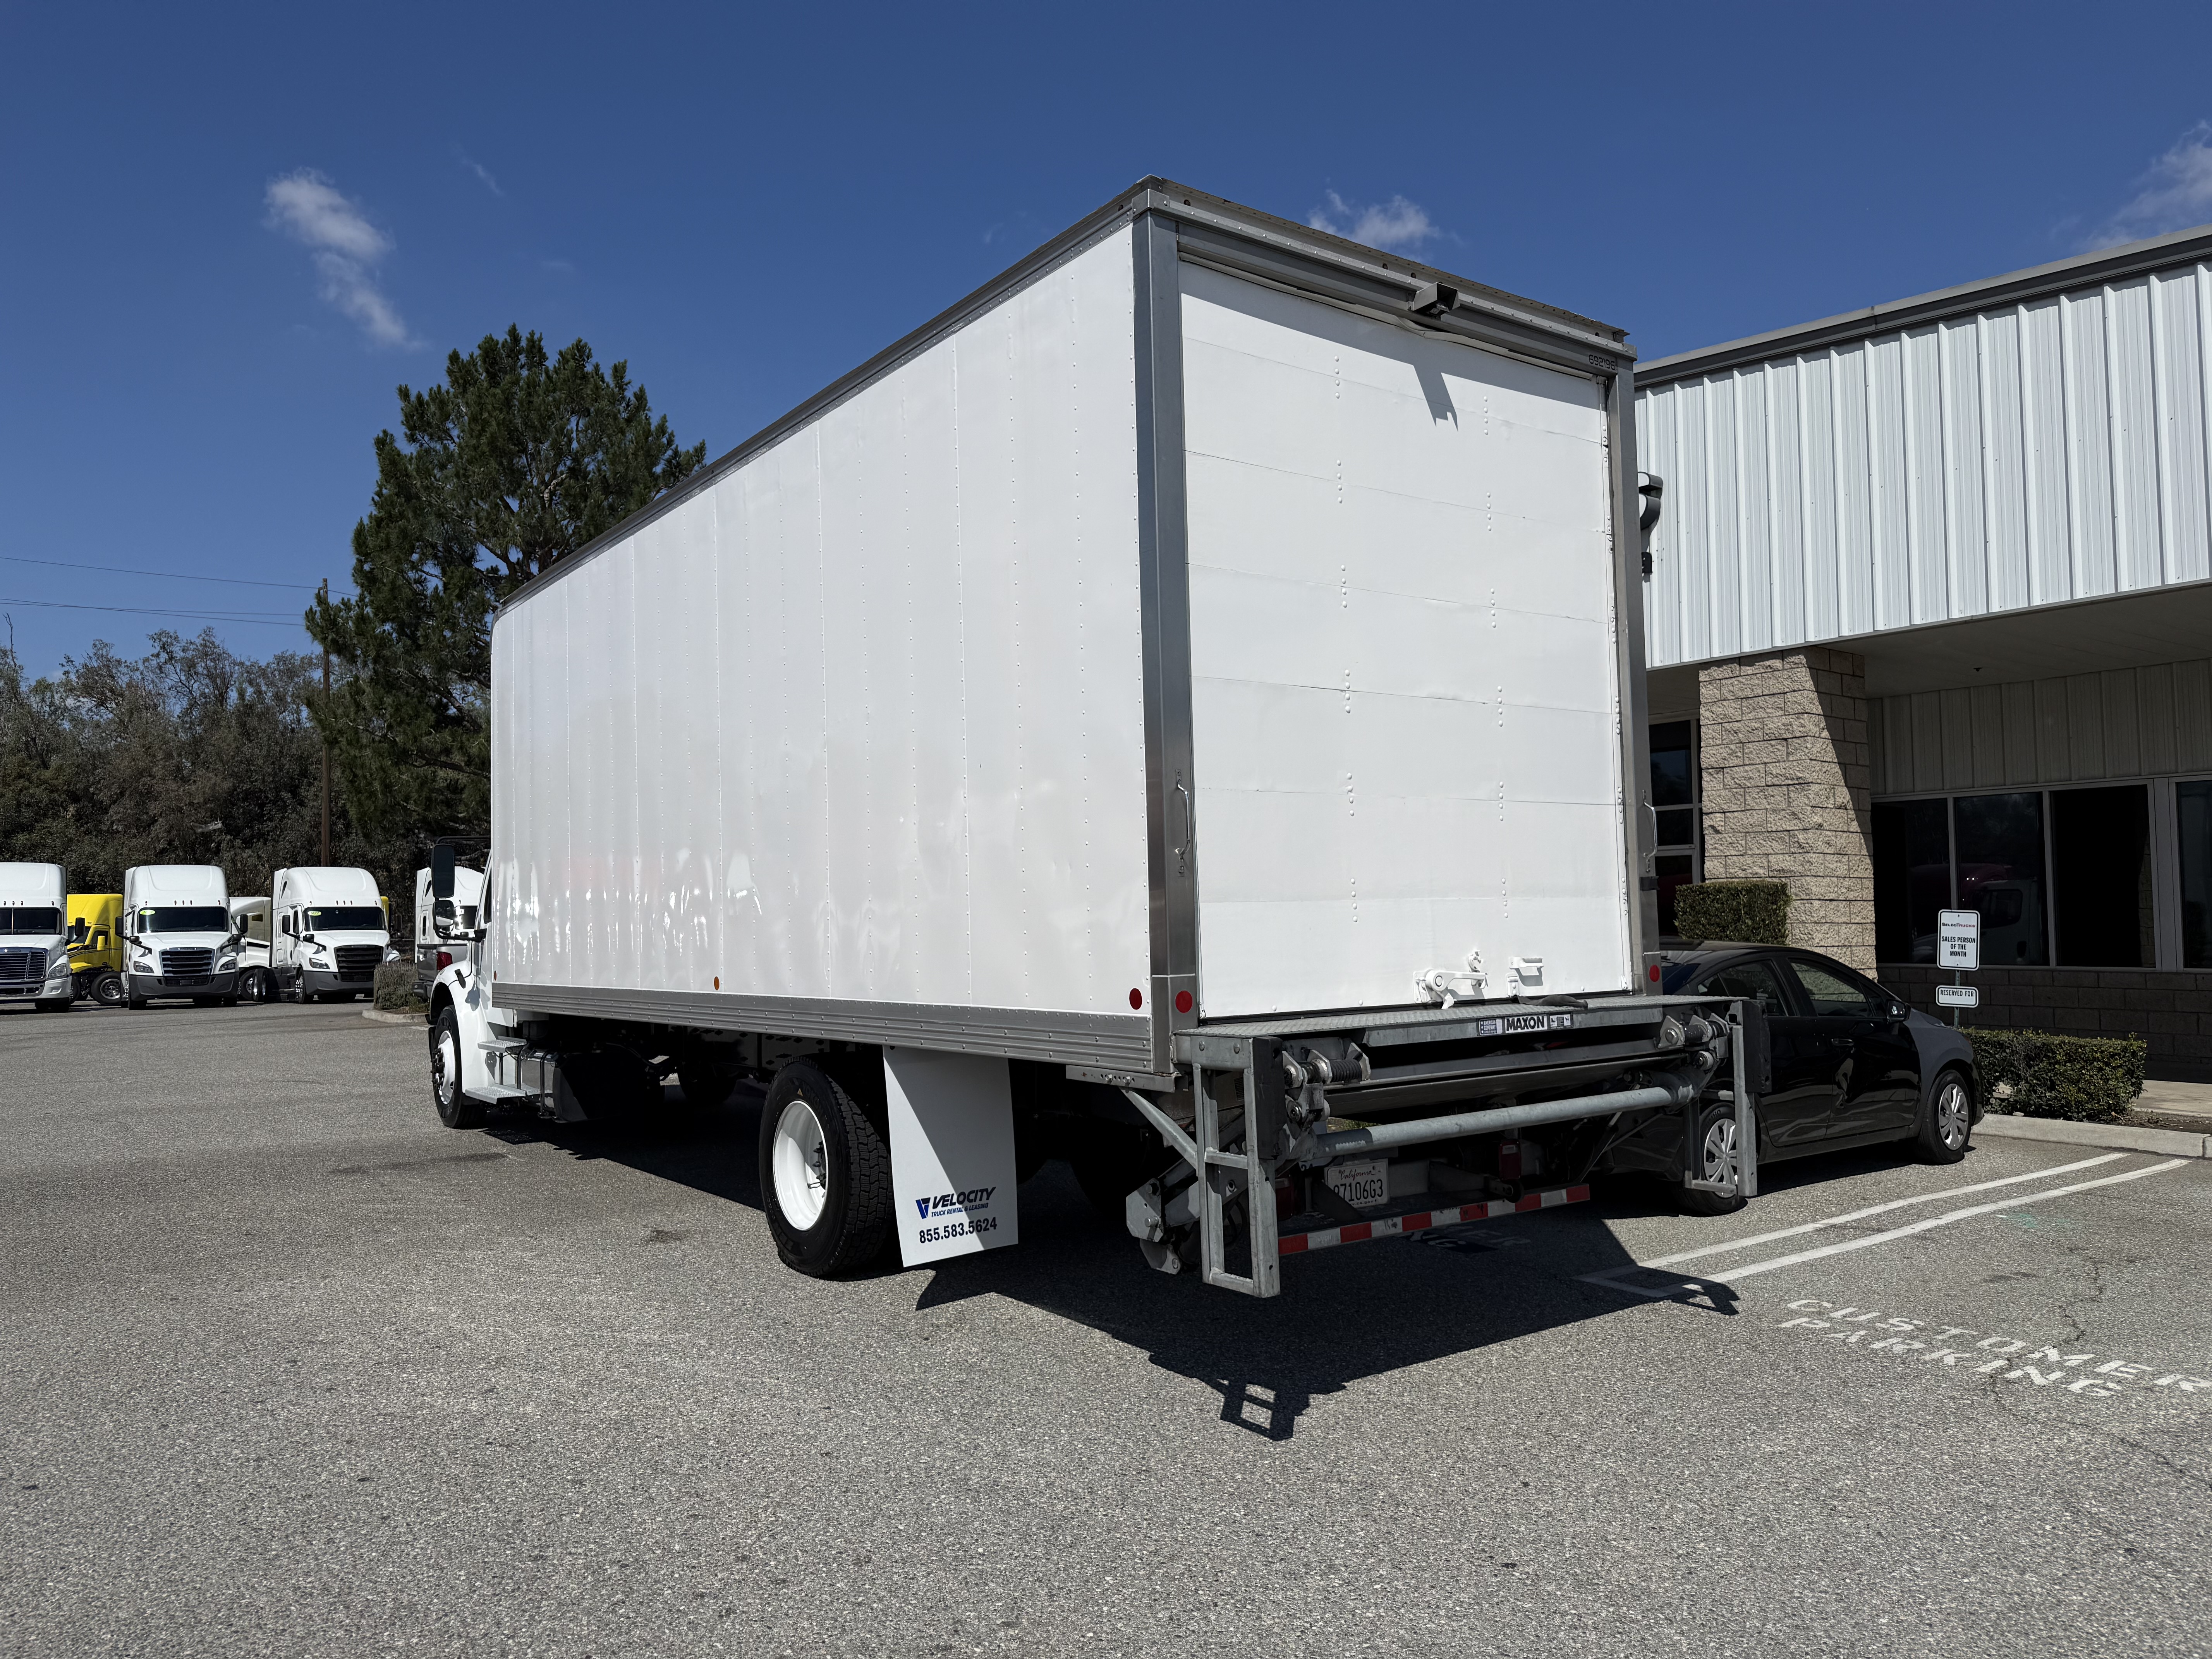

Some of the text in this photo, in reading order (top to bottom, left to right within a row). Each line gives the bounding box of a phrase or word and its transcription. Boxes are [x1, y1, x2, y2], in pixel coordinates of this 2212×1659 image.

[1589, 354, 1616, 371] 692196
[1506, 1015, 1545, 1032] MAXON
[1340, 1169, 1376, 1181] California
[932, 1187, 996, 1209] VELOCITY
[931, 1209, 946, 1218] TRUCK
[969, 1202, 989, 1211] LEASING
[919, 1217, 997, 1243] 855.583.5624
[1787, 1300, 2212, 1393] CUSTOMER
[1778, 1317, 2123, 1397] PARKING
